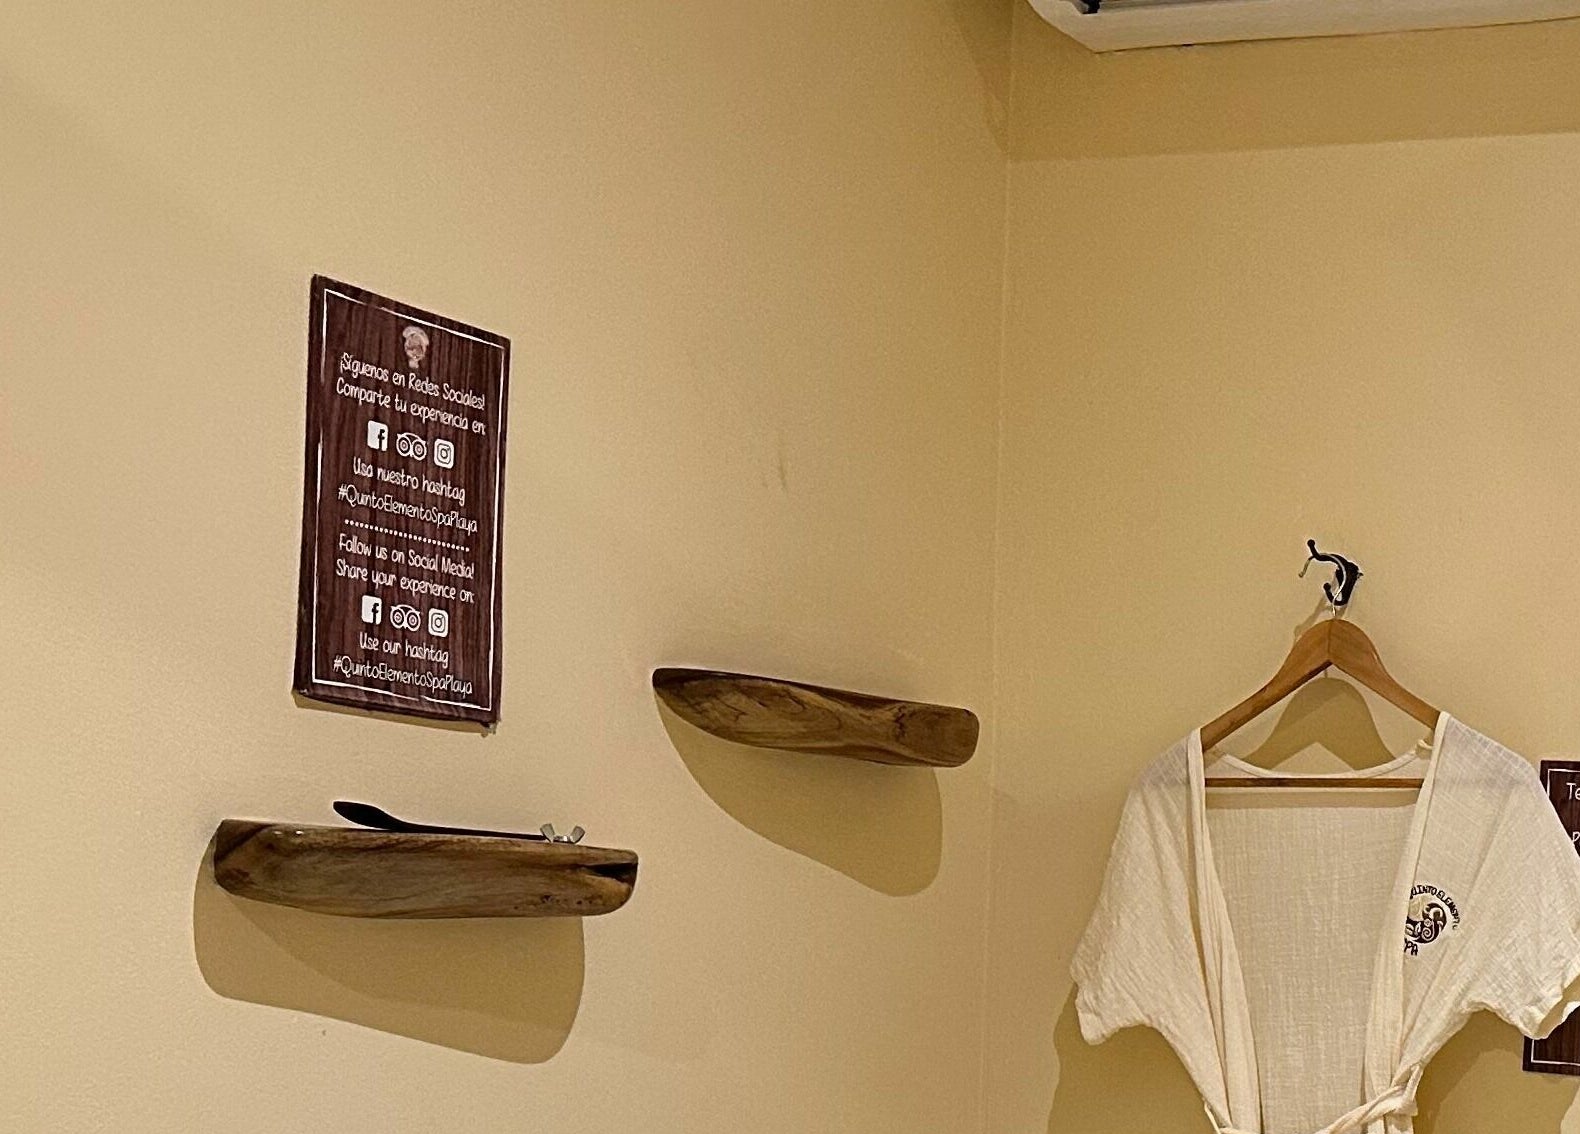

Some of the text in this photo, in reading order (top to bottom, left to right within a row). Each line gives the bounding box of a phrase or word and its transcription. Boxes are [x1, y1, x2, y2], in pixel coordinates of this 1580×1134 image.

[336, 377, 391, 408] Comparte
[395, 394, 407, 413] tu
[411, 402, 468, 431] experiencia
[392, 372, 405, 388] en
[408, 373, 439, 397] Redes
[442, 383, 485, 410] Sociales!
[353, 457, 466, 507] Usa nuestro hashtag
[339, 533, 475, 579] Follow us on Social Media!
[336, 558, 368, 581] Share
[371, 570, 397, 589] your
[400, 576, 456, 600] experience
[360, 632, 449, 669] Use our hashtag
